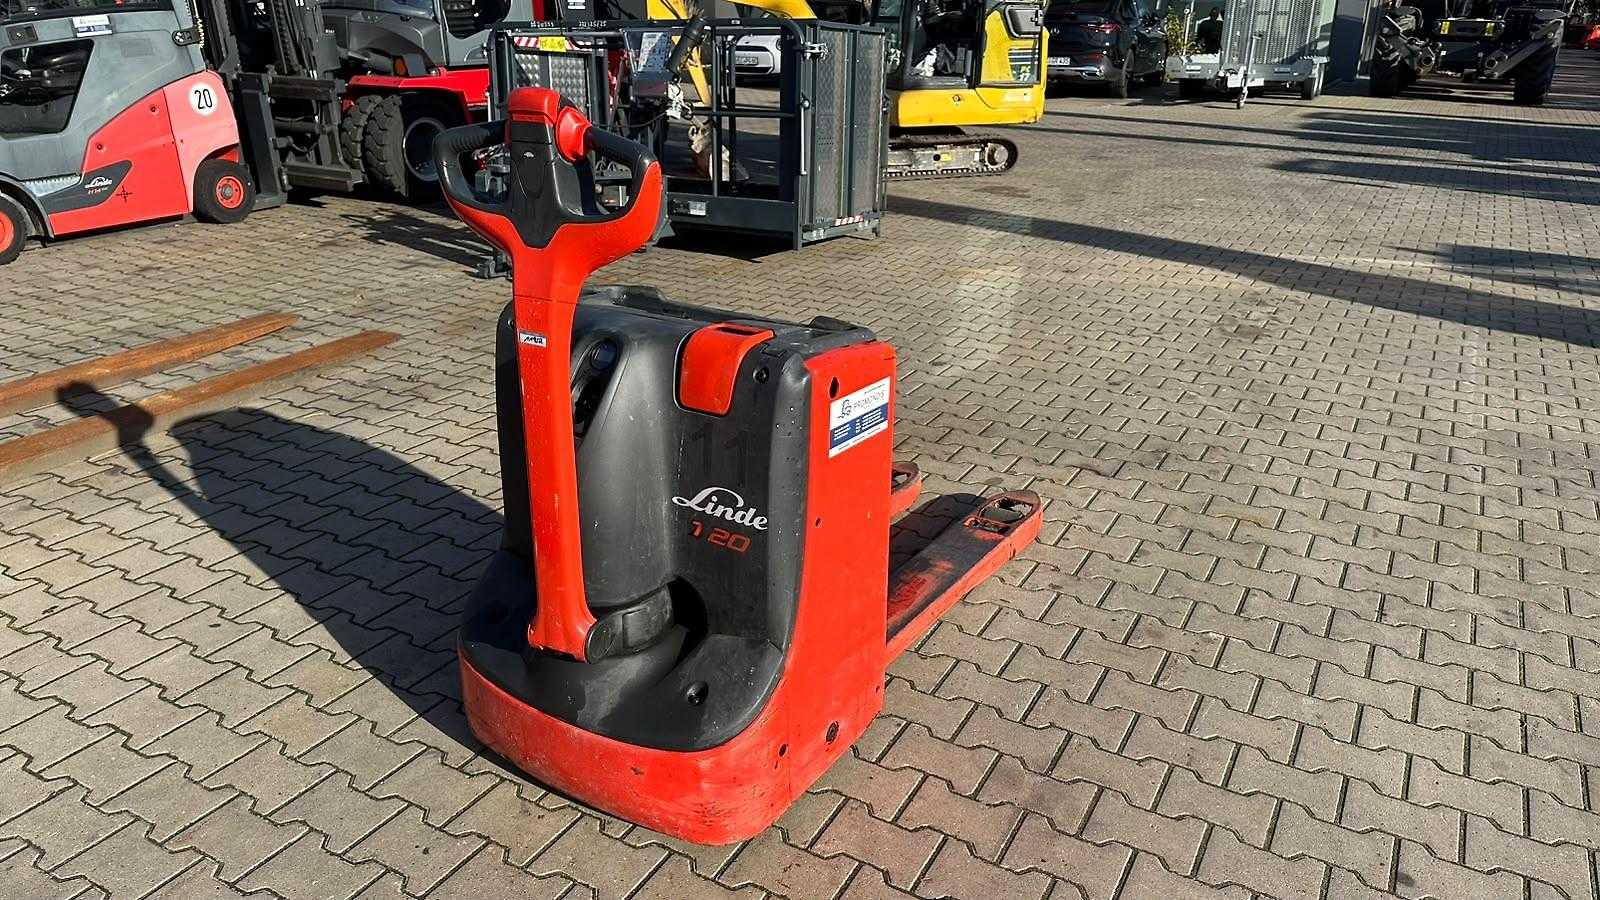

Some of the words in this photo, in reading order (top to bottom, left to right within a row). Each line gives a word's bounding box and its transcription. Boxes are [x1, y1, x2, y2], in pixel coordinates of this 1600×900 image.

[194, 88, 213, 110] 20
[84, 176, 113, 189] Linde
[671, 486, 768, 531] Linde
